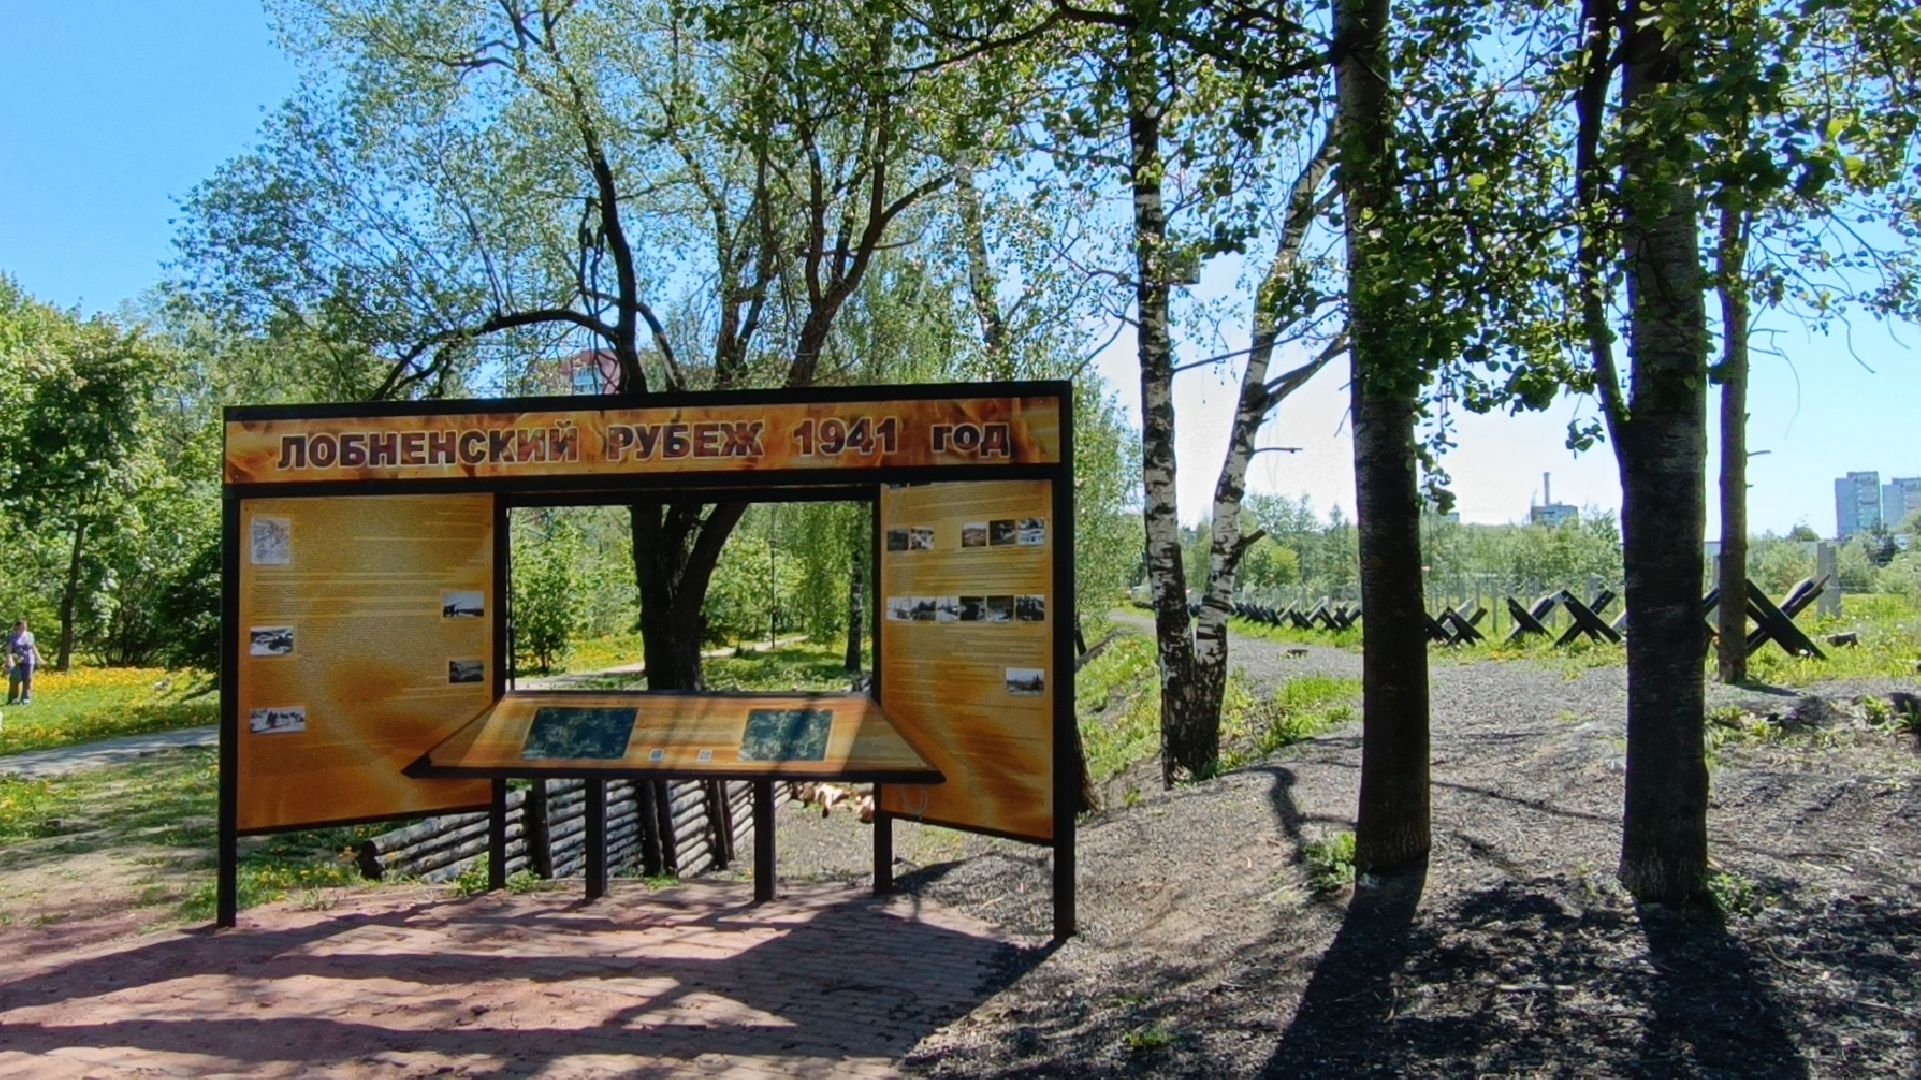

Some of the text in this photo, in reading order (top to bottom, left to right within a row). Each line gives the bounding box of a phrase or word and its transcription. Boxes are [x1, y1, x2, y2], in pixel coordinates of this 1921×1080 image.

[278, 419, 579, 469] ЛОБНЕНСКИЙ
[607, 419, 765, 461] РУБЕЖ
[793, 416, 898, 456] 1941
